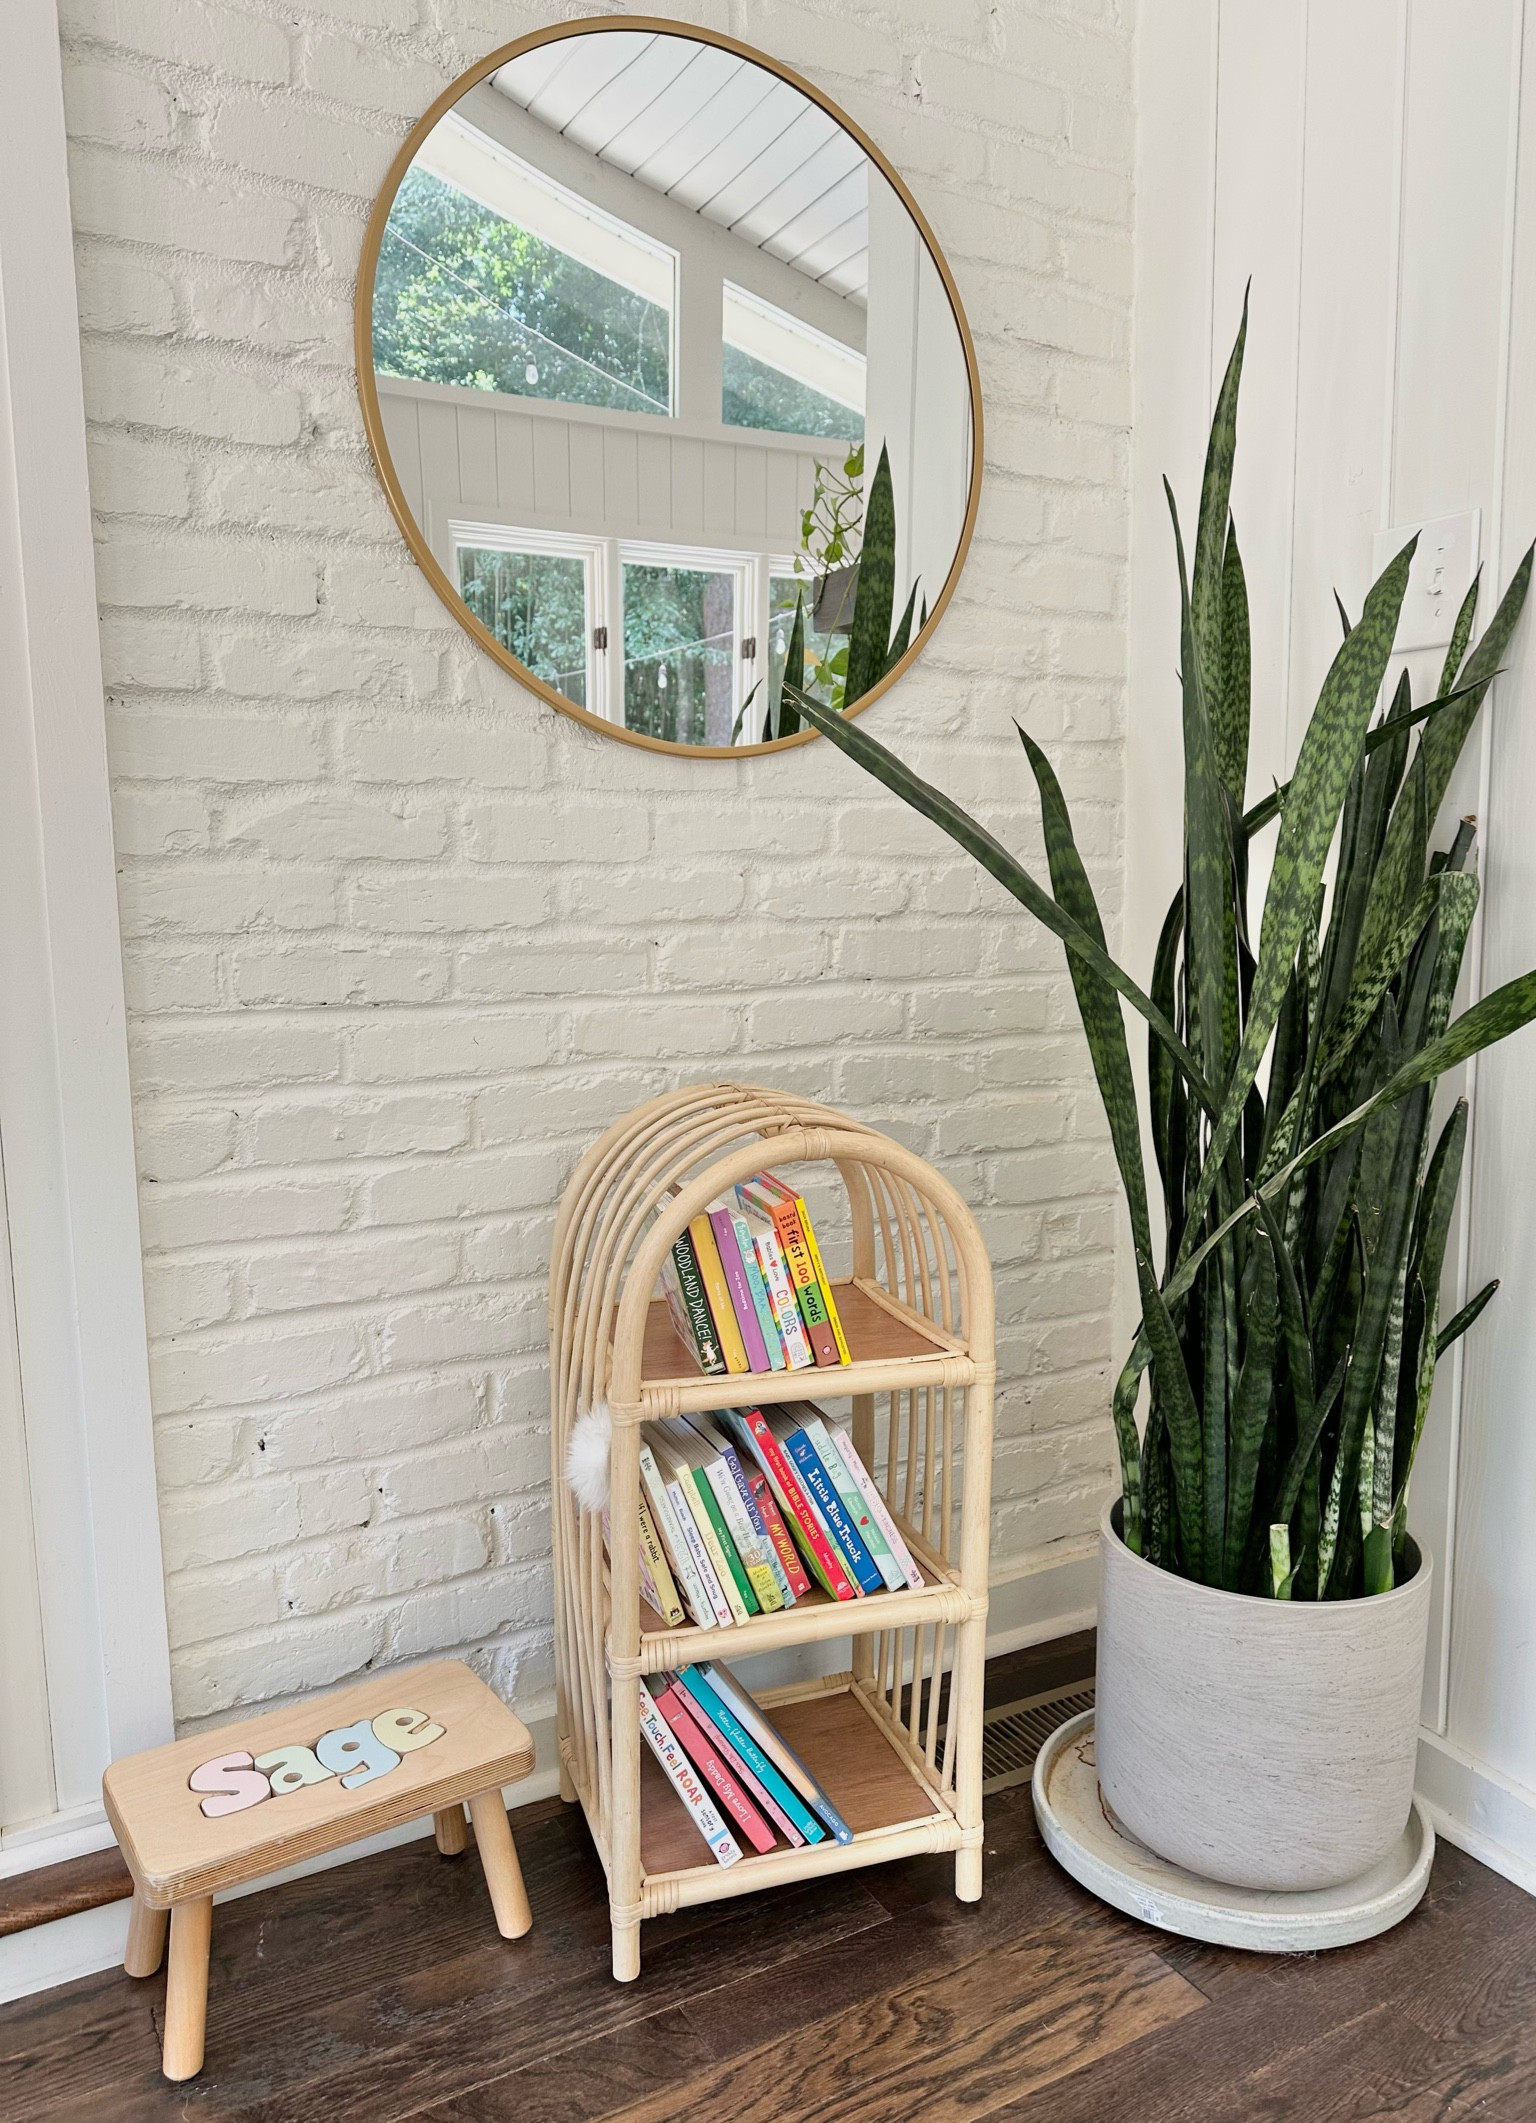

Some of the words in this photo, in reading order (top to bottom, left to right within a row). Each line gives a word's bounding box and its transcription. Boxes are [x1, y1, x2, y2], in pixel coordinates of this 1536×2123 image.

[766, 1242, 774, 1260] Babies
[772, 1268, 780, 1281] Love
[787, 1230, 804, 1259] first
[796, 1262, 810, 1284] 100
[804, 1286, 822, 1323] words
[675, 1236, 699, 1298] WOODLAND
[689, 1298, 712, 1340] DANCE!
[776, 1290, 797, 1335] COLORS
[734, 1473, 749, 1499] Gave
[750, 1511, 761, 1531] You
[774, 1456, 782, 1468] first
[779, 1467, 789, 1481] book
[788, 1488, 803, 1508] BIBLE
[801, 1510, 819, 1539] STORIES
[808, 1468, 830, 1503] Little
[826, 1502, 843, 1528] Blue
[839, 1527, 862, 1563] Truck
[639, 1516, 649, 1533] were
[770, 1523, 785, 1538] MY
[687, 1527, 697, 1545] Sleep
[693, 1544, 703, 1560] Baby,
[699, 1559, 708, 1573] Safe
[705, 1573, 713, 1584] and
[709, 1584, 719, 1600] Snug
[705, 1532, 719, 1556] Dear
[716, 1558, 727, 1577] Zoo
[724, 1545, 733, 1558] Signs
[777, 1538, 800, 1575] WORLD
[646, 1714, 667, 1749] Touch,
[663, 1744, 682, 1770] Feel
[676, 1769, 702, 1806] ROAR
[706, 1759, 725, 1786] Daddy
[746, 1748, 767, 1774] Butterfly
[722, 1784, 734, 1799] My
[732, 1798, 748, 1818] Love
[701, 1809, 714, 1831] sensory
[819, 1804, 839, 1827] AVOCADO
